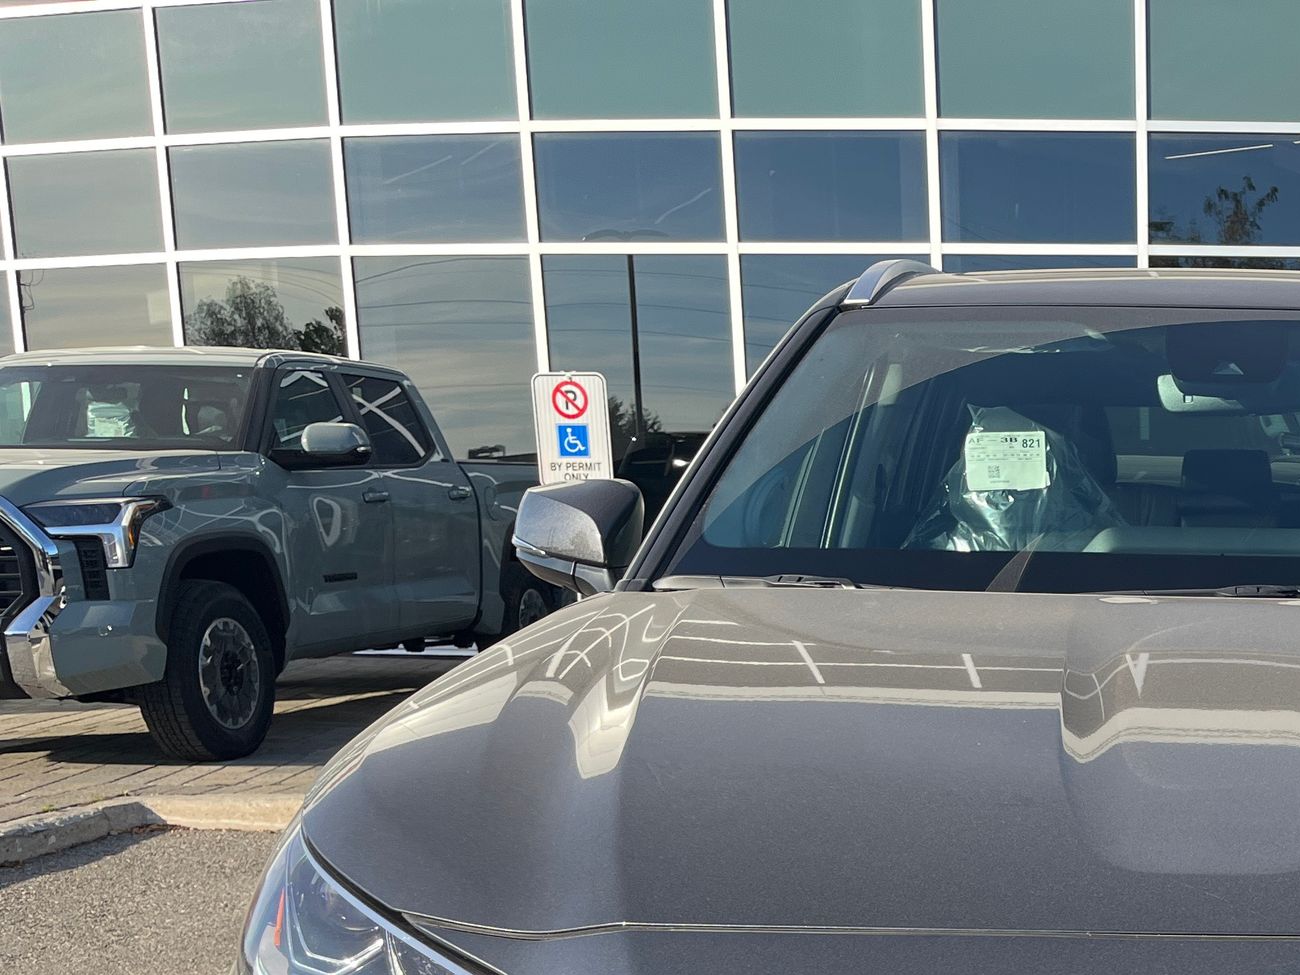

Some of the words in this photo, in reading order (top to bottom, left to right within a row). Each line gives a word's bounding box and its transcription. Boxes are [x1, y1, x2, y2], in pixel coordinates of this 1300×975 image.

[1022, 438, 1041, 448] 821
[550, 463, 563, 472] BY
[565, 462, 603, 471] PERMIT
